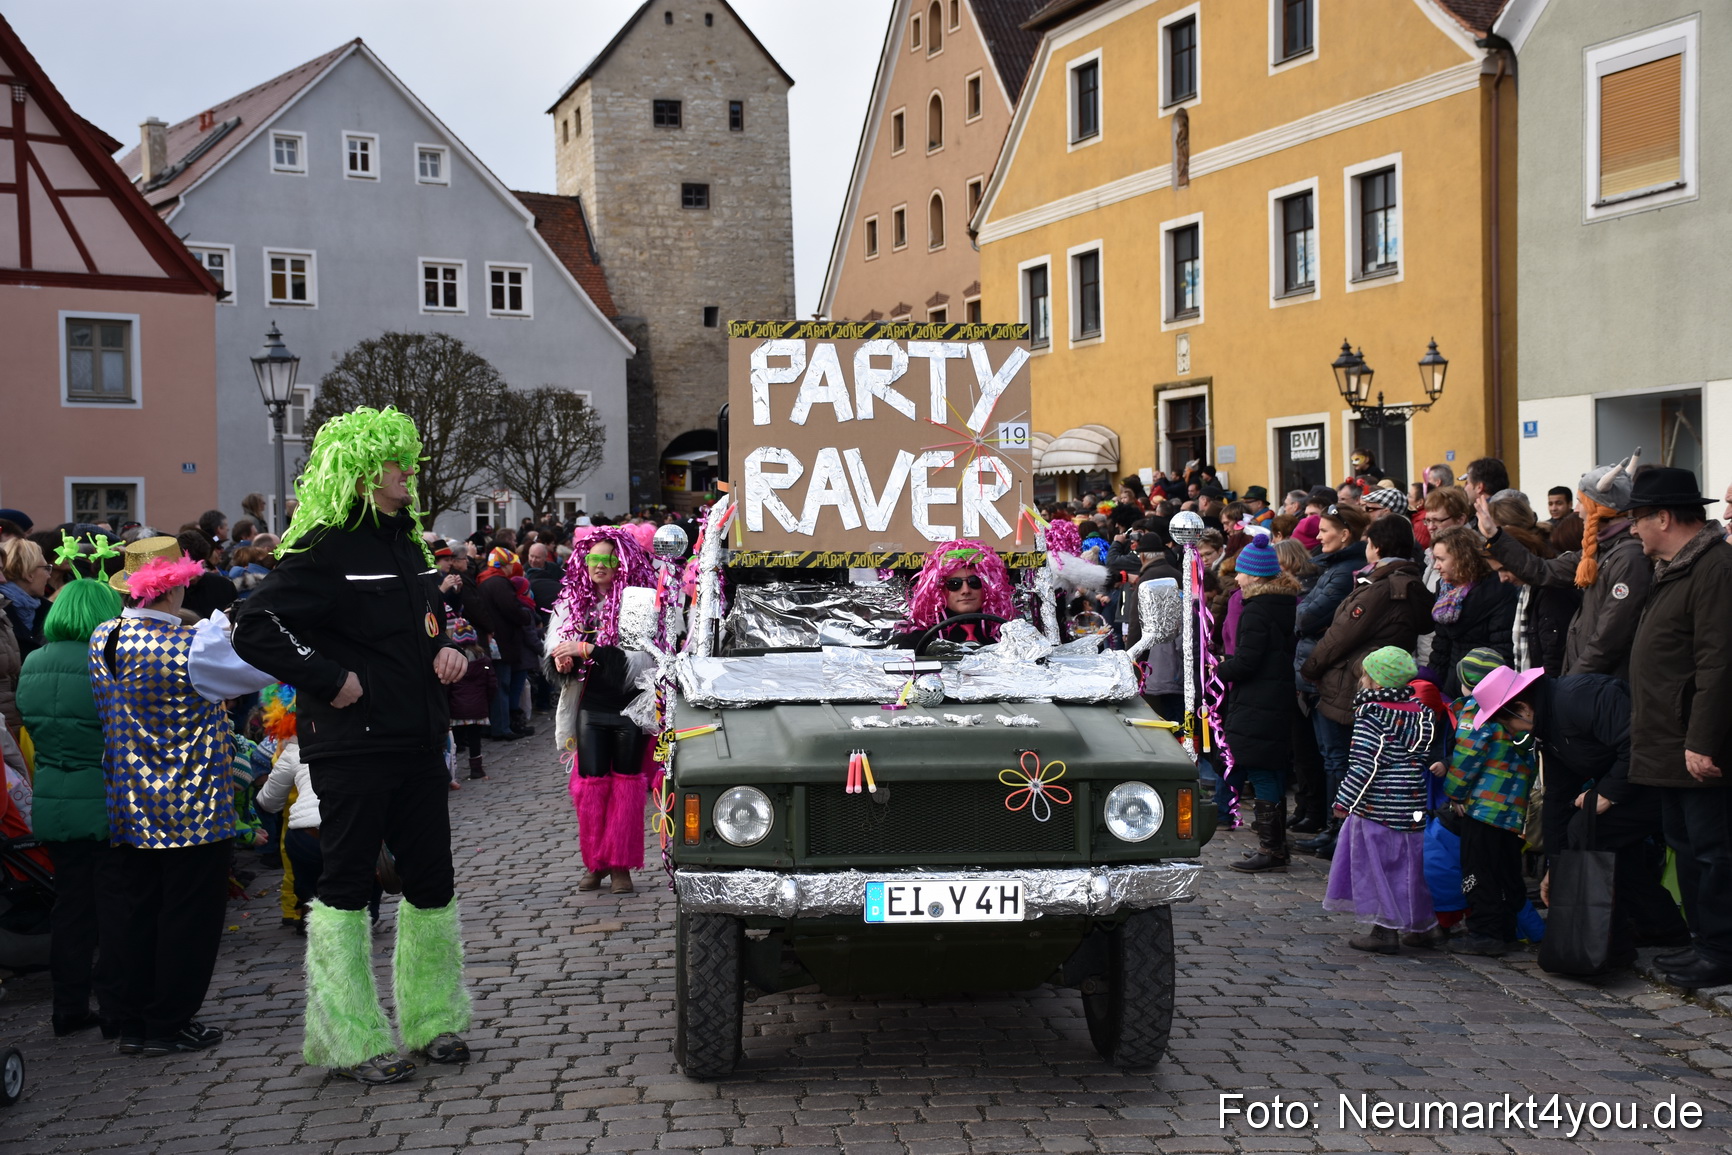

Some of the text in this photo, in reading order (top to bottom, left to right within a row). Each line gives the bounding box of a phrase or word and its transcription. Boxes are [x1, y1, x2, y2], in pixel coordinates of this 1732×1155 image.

[756, 325, 783, 338] ZONE
[800, 325, 832, 338] PARTY
[836, 325, 864, 338] ZONE
[880, 325, 913, 339] PARTY
[916, 326, 944, 339] ZONE
[960, 326, 993, 339] PARTY
[996, 326, 1023, 339] ZONE
[750, 339, 1030, 433] PARTY
[1002, 426, 1026, 444] 19
[1292, 432, 1317, 448] BW
[745, 446, 1013, 542] RAVER
[735, 553, 769, 567] PARTY
[772, 553, 800, 567] ZONE
[816, 553, 850, 567] PARTY
[853, 554, 881, 567] ZONE
[1016, 553, 1043, 567] ZONE
[888, 886, 925, 916] EI
[871, 906, 879, 916] D
